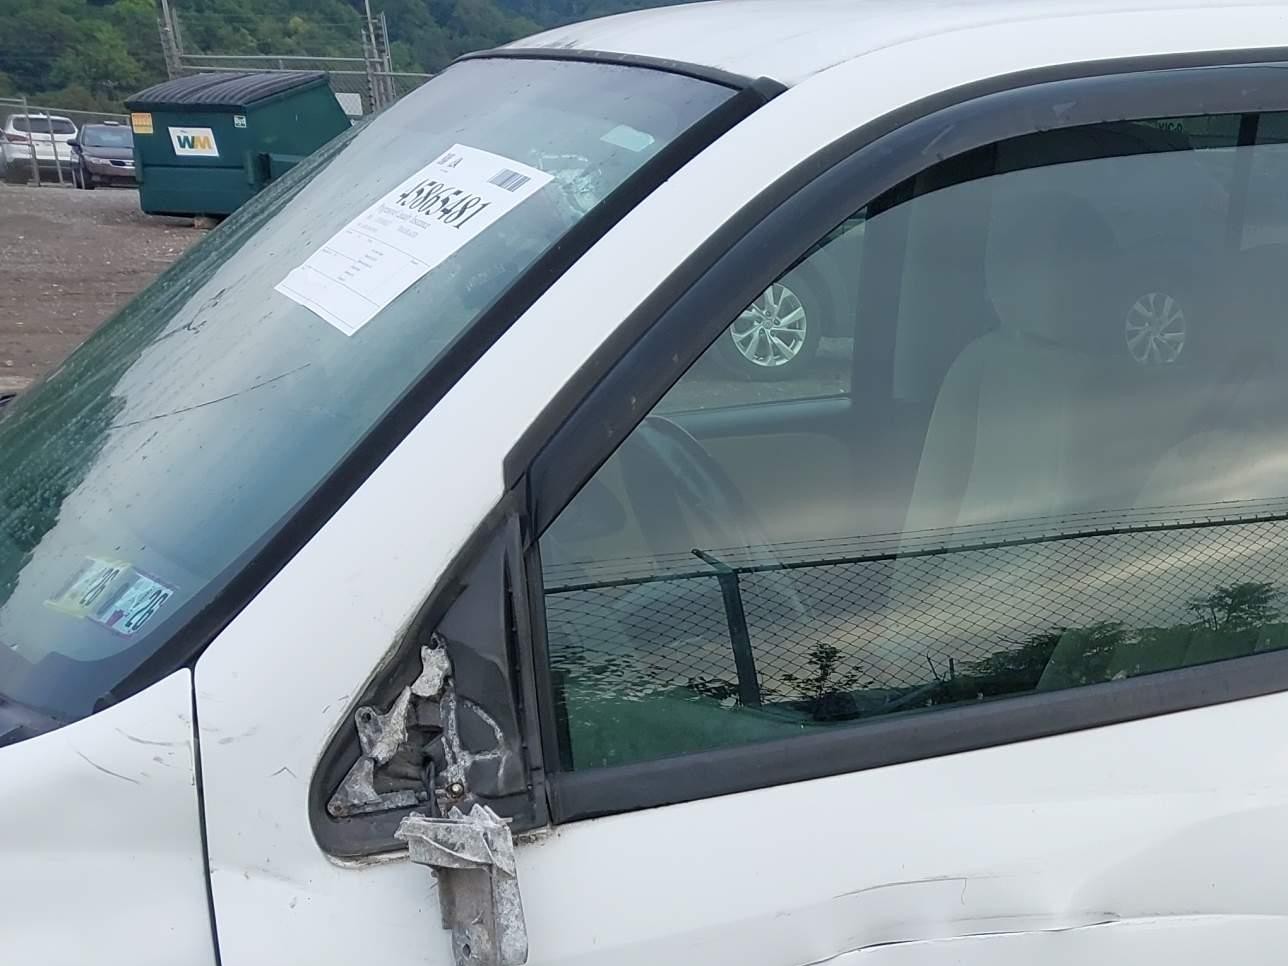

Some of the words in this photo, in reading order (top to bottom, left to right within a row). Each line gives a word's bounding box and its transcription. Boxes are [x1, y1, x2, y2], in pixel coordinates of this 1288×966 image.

[177, 135, 212, 149] WM
[396, 179, 491, 229] 45865481
[124, 588, 168, 631] 26
